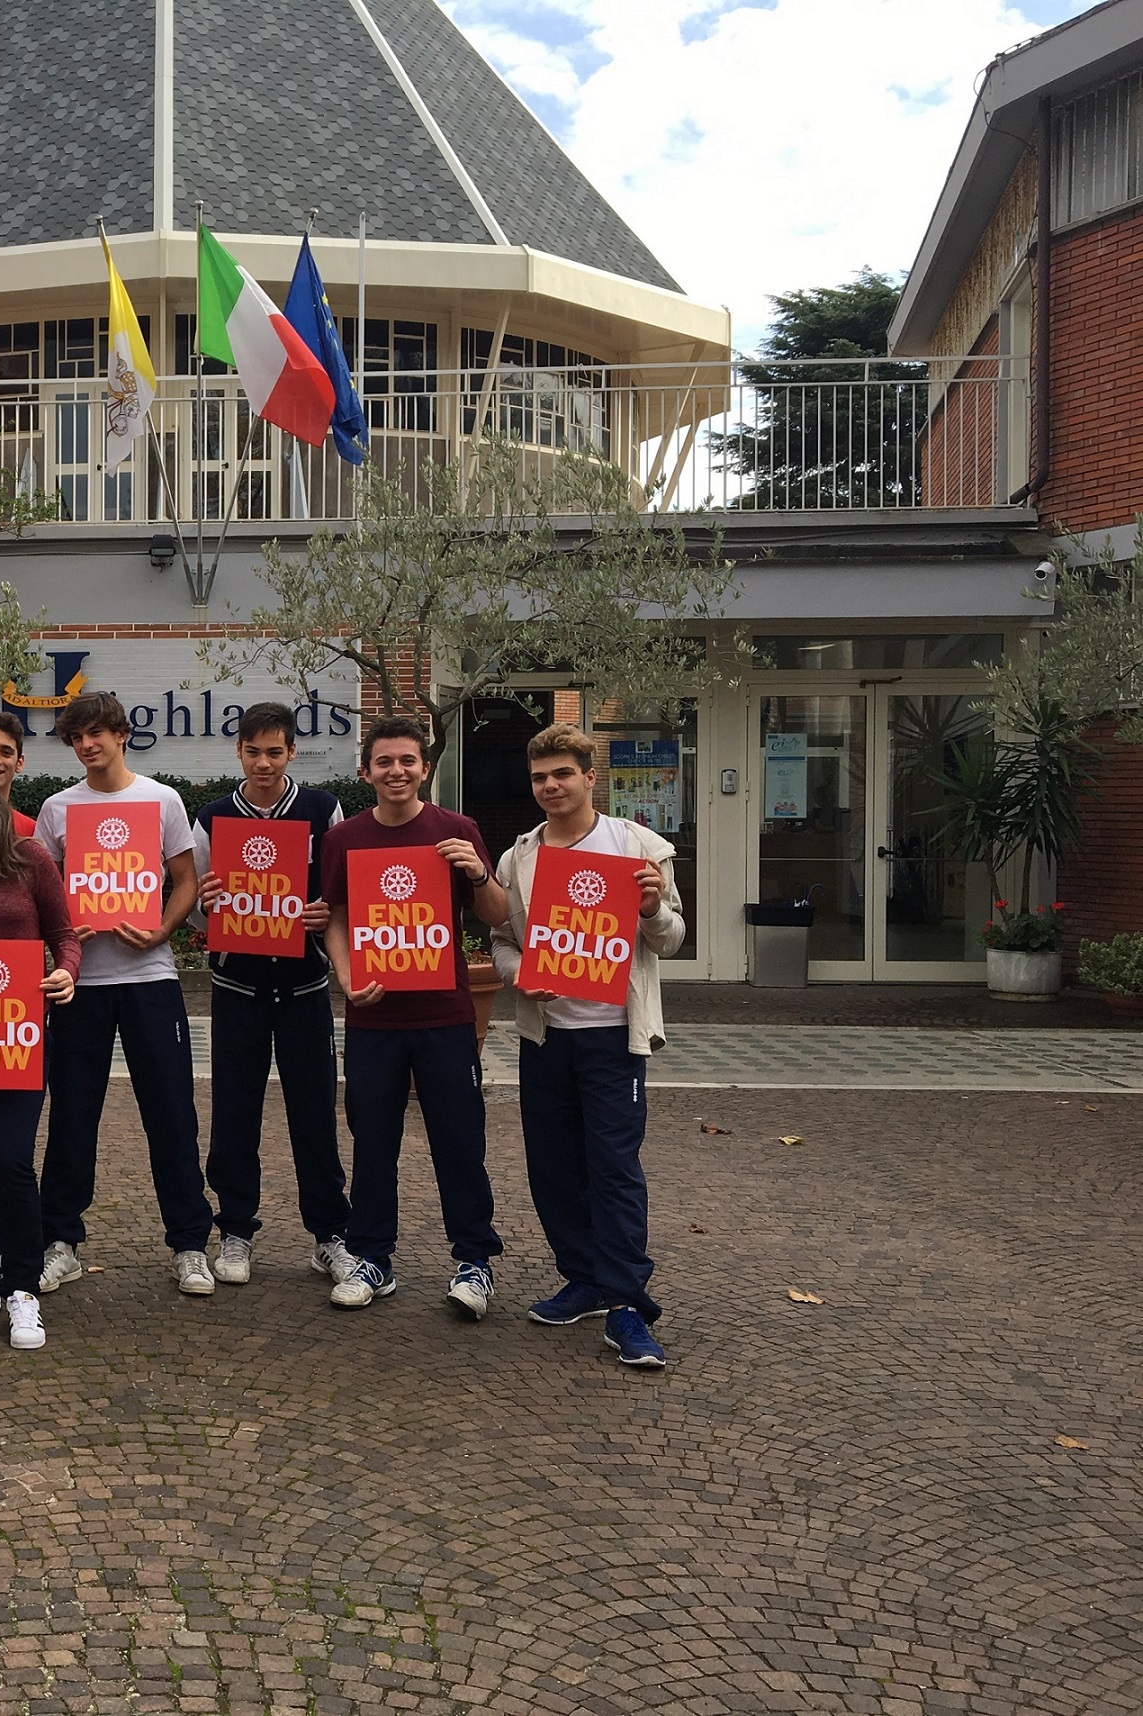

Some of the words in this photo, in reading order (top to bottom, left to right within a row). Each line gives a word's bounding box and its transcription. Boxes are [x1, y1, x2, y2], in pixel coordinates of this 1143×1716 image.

[2, 652, 352, 750] Hghlads
[24, 694, 76, 706] ALTIOR
[84, 852, 144, 872] END
[69, 870, 157, 894] POLIO
[228, 872, 292, 896] END
[78, 892, 150, 914] NOW
[214, 893, 303, 918] POLIO
[368, 904, 434, 926] END
[222, 916, 295, 940] NOW
[549, 906, 618, 936] END
[354, 924, 450, 950] POLIO
[529, 924, 630, 964] POLIO
[366, 948, 442, 972] NOW
[536, 948, 617, 983] NOW
